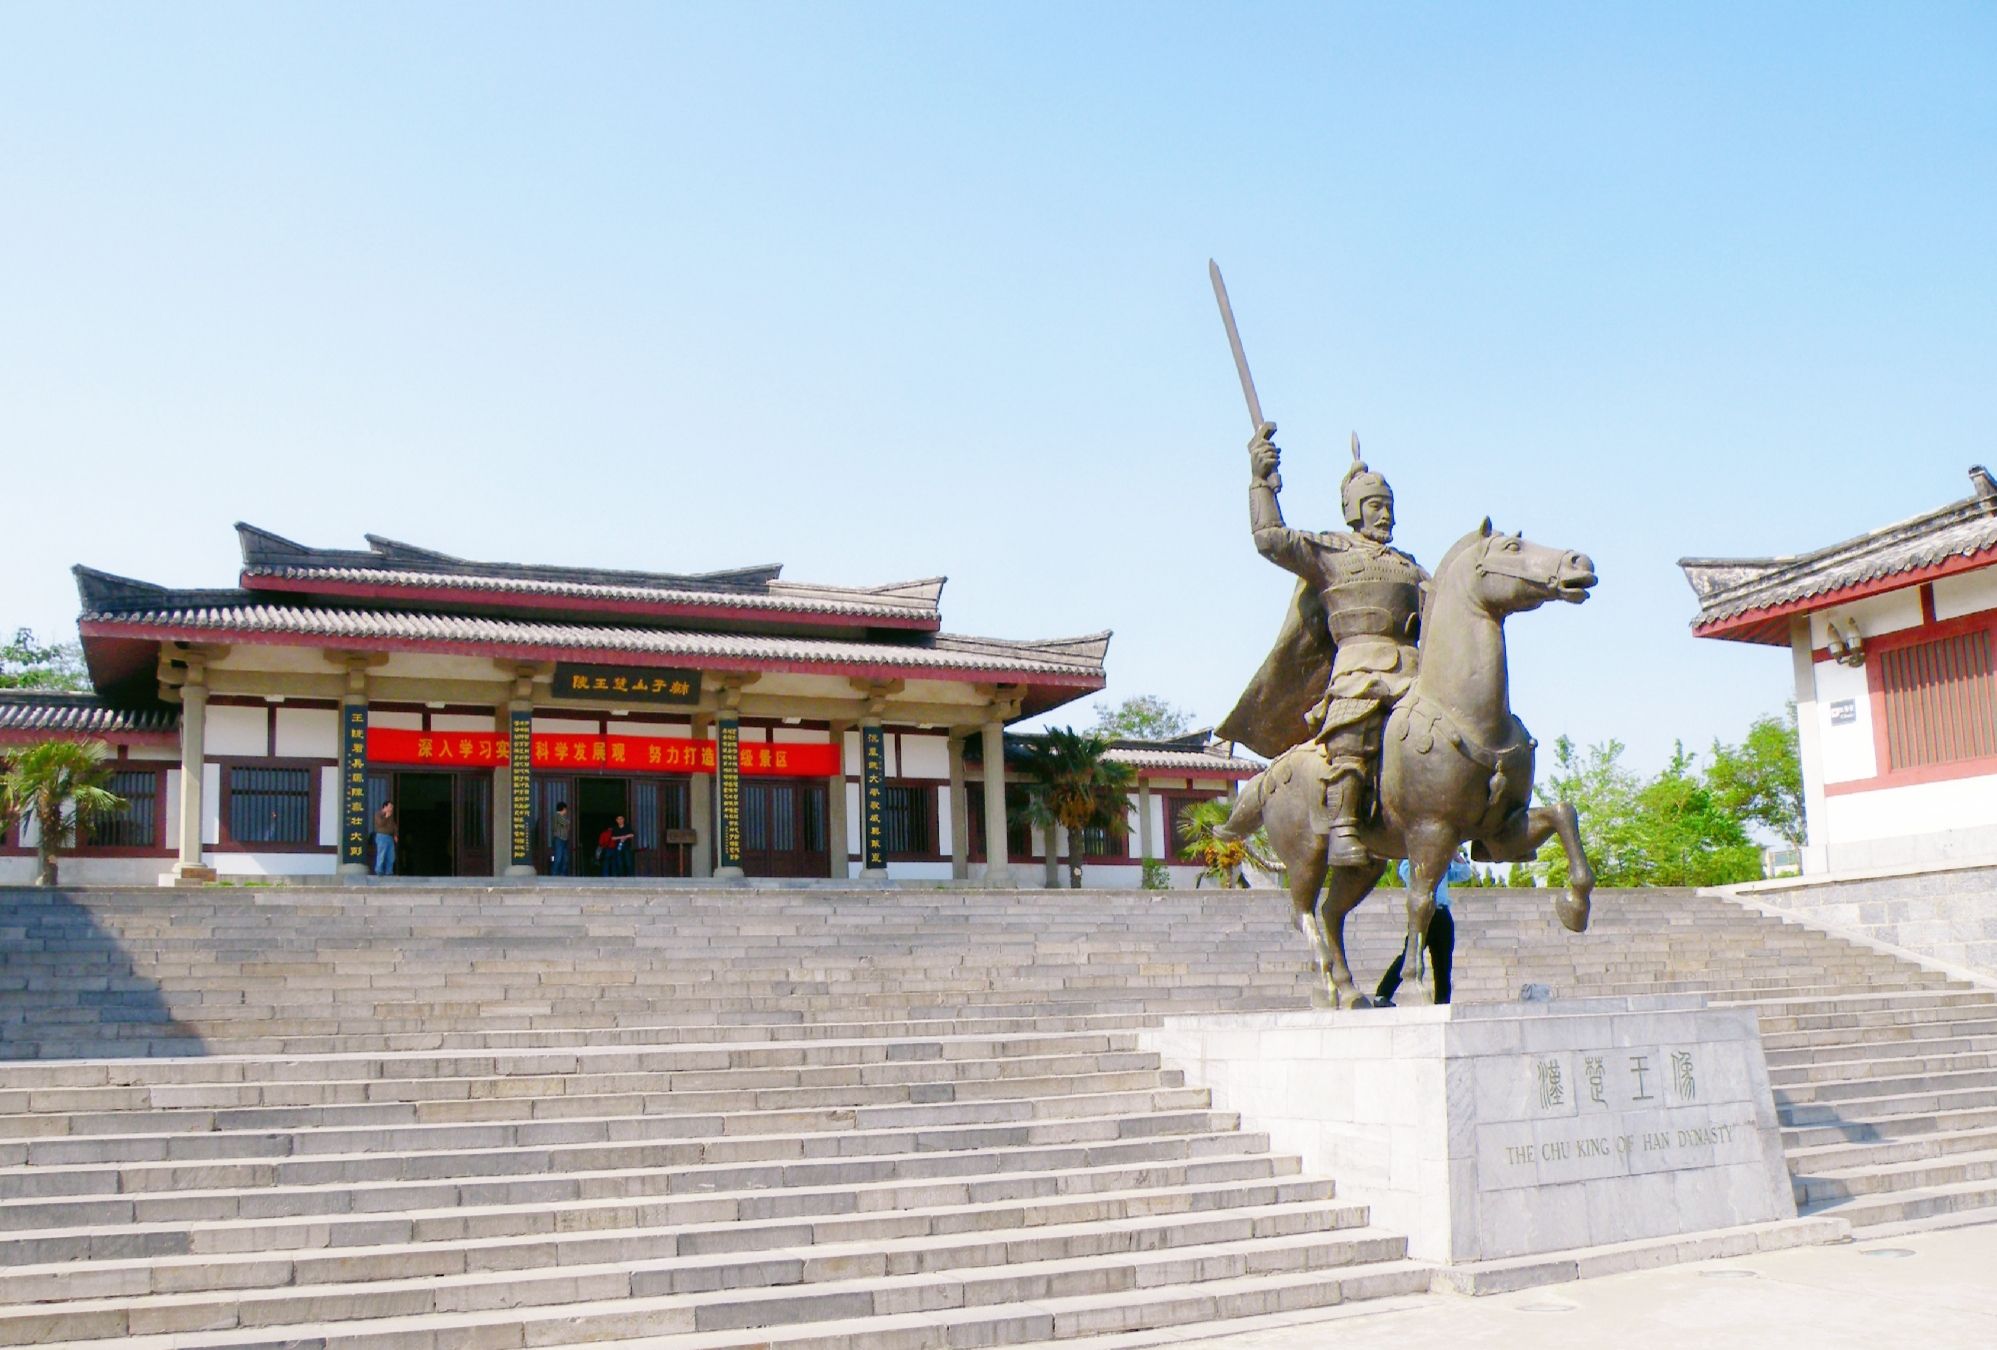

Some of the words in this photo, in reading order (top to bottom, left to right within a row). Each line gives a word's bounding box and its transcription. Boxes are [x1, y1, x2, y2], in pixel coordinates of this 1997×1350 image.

[418, 738, 627, 763] 深入学习实科学发展观
[1505, 1145, 1536, 1165] THE
[1541, 1141, 1570, 1162] CHU
[1576, 1137, 1610, 1158] KING
[1616, 1135, 1634, 1153] OF
[1642, 1131, 1669, 1152] HAN
[1677, 1124, 1732, 1148] DYNASTY
